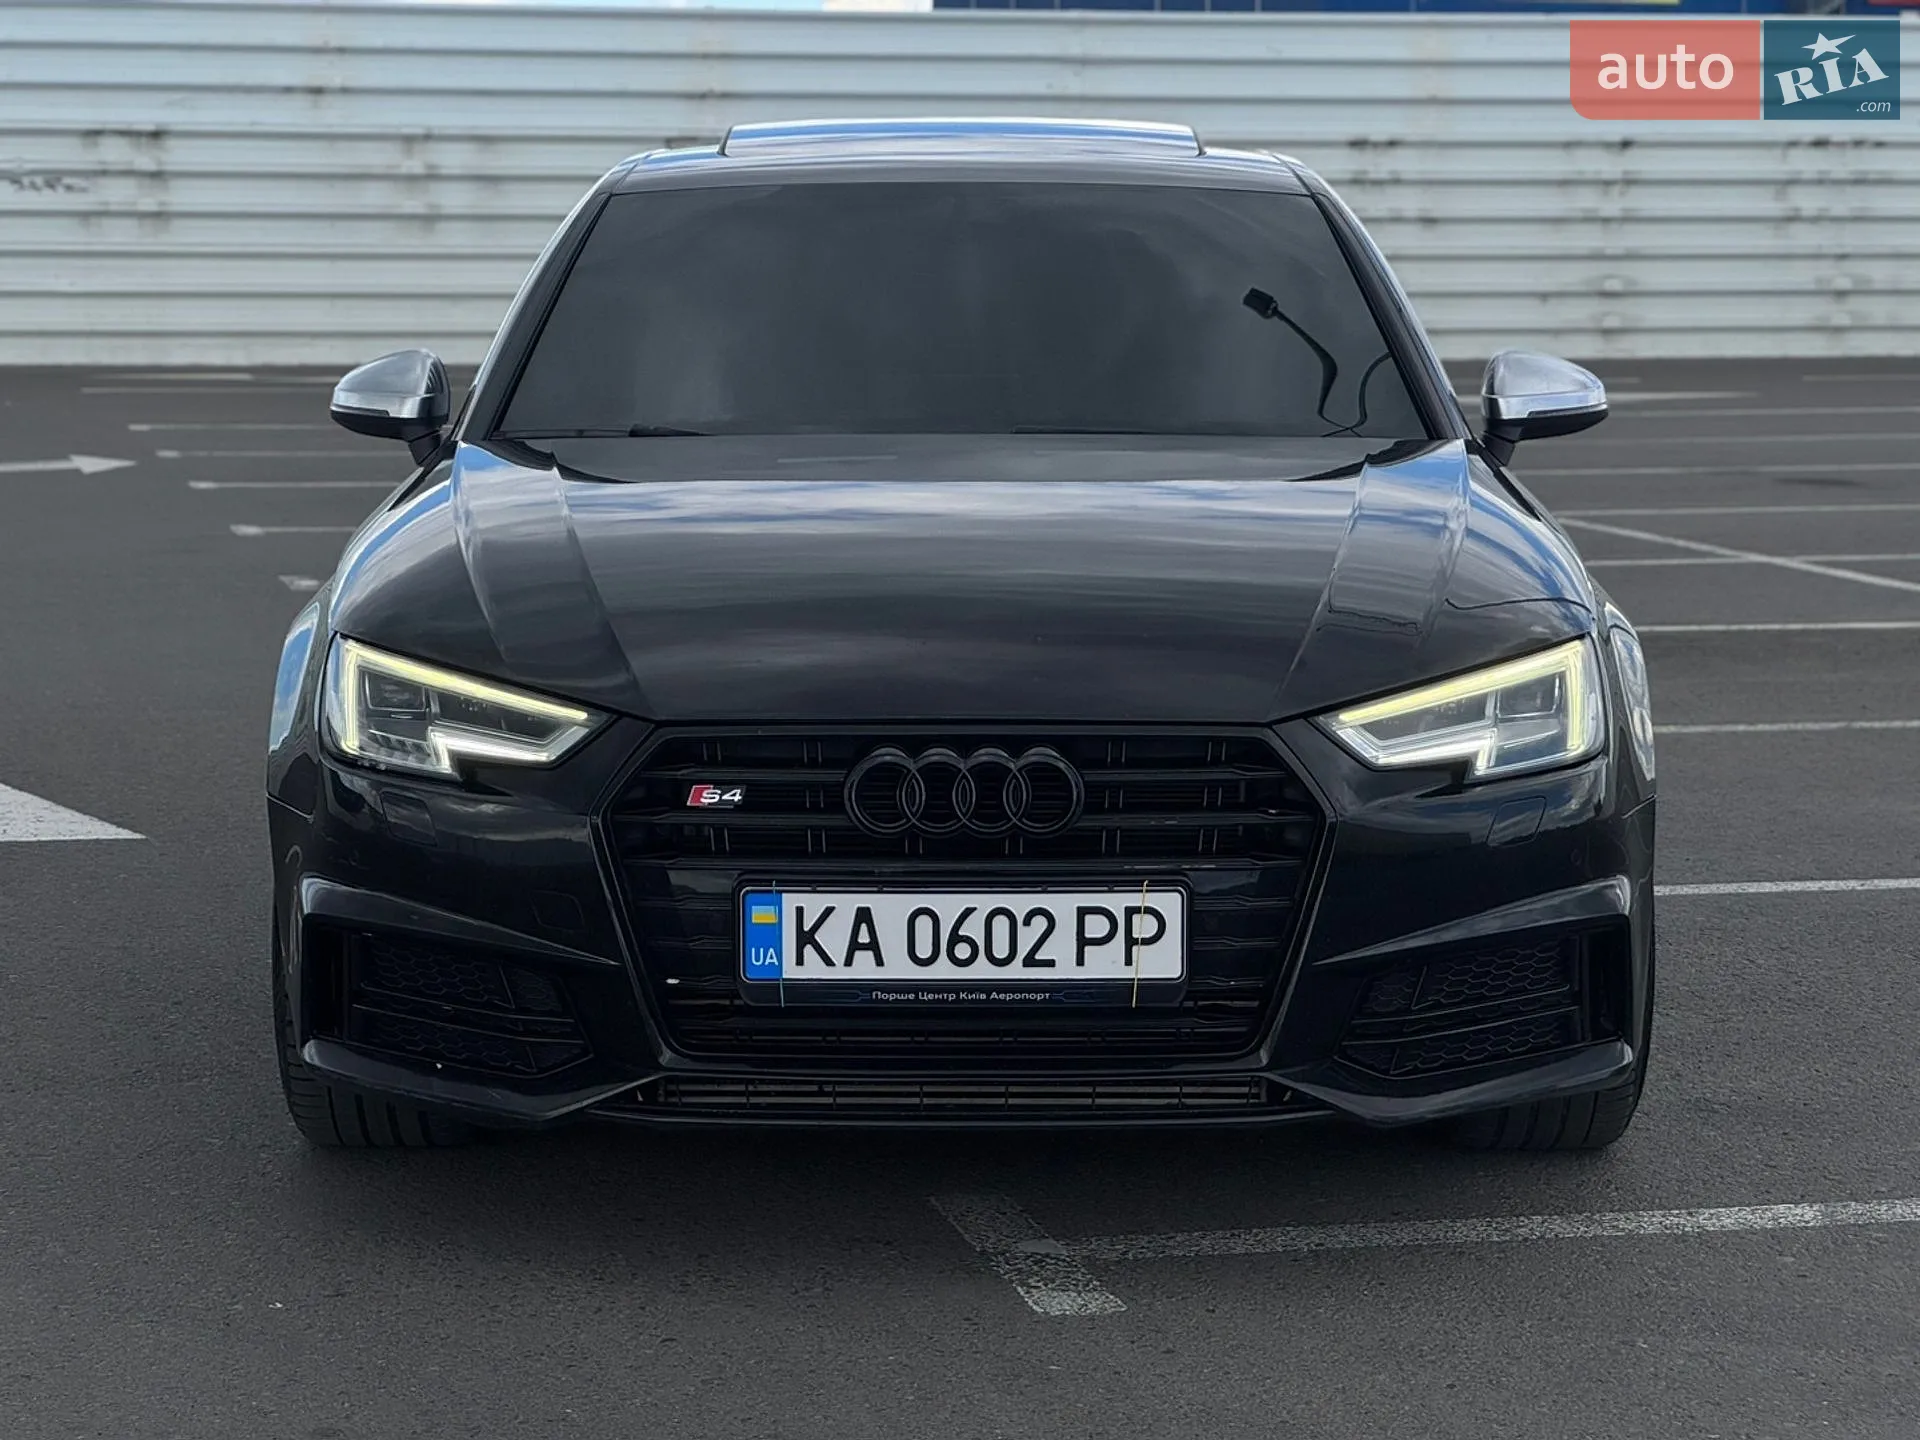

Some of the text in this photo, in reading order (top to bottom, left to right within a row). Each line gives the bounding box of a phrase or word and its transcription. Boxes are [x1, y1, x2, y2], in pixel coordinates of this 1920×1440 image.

[698, 788, 743, 804] S4
[793, 904, 1167, 968] KA 0602 PP
[750, 947, 779, 967] UA
[872, 990, 1051, 1001] Порше Центр Київ Аеропорт
